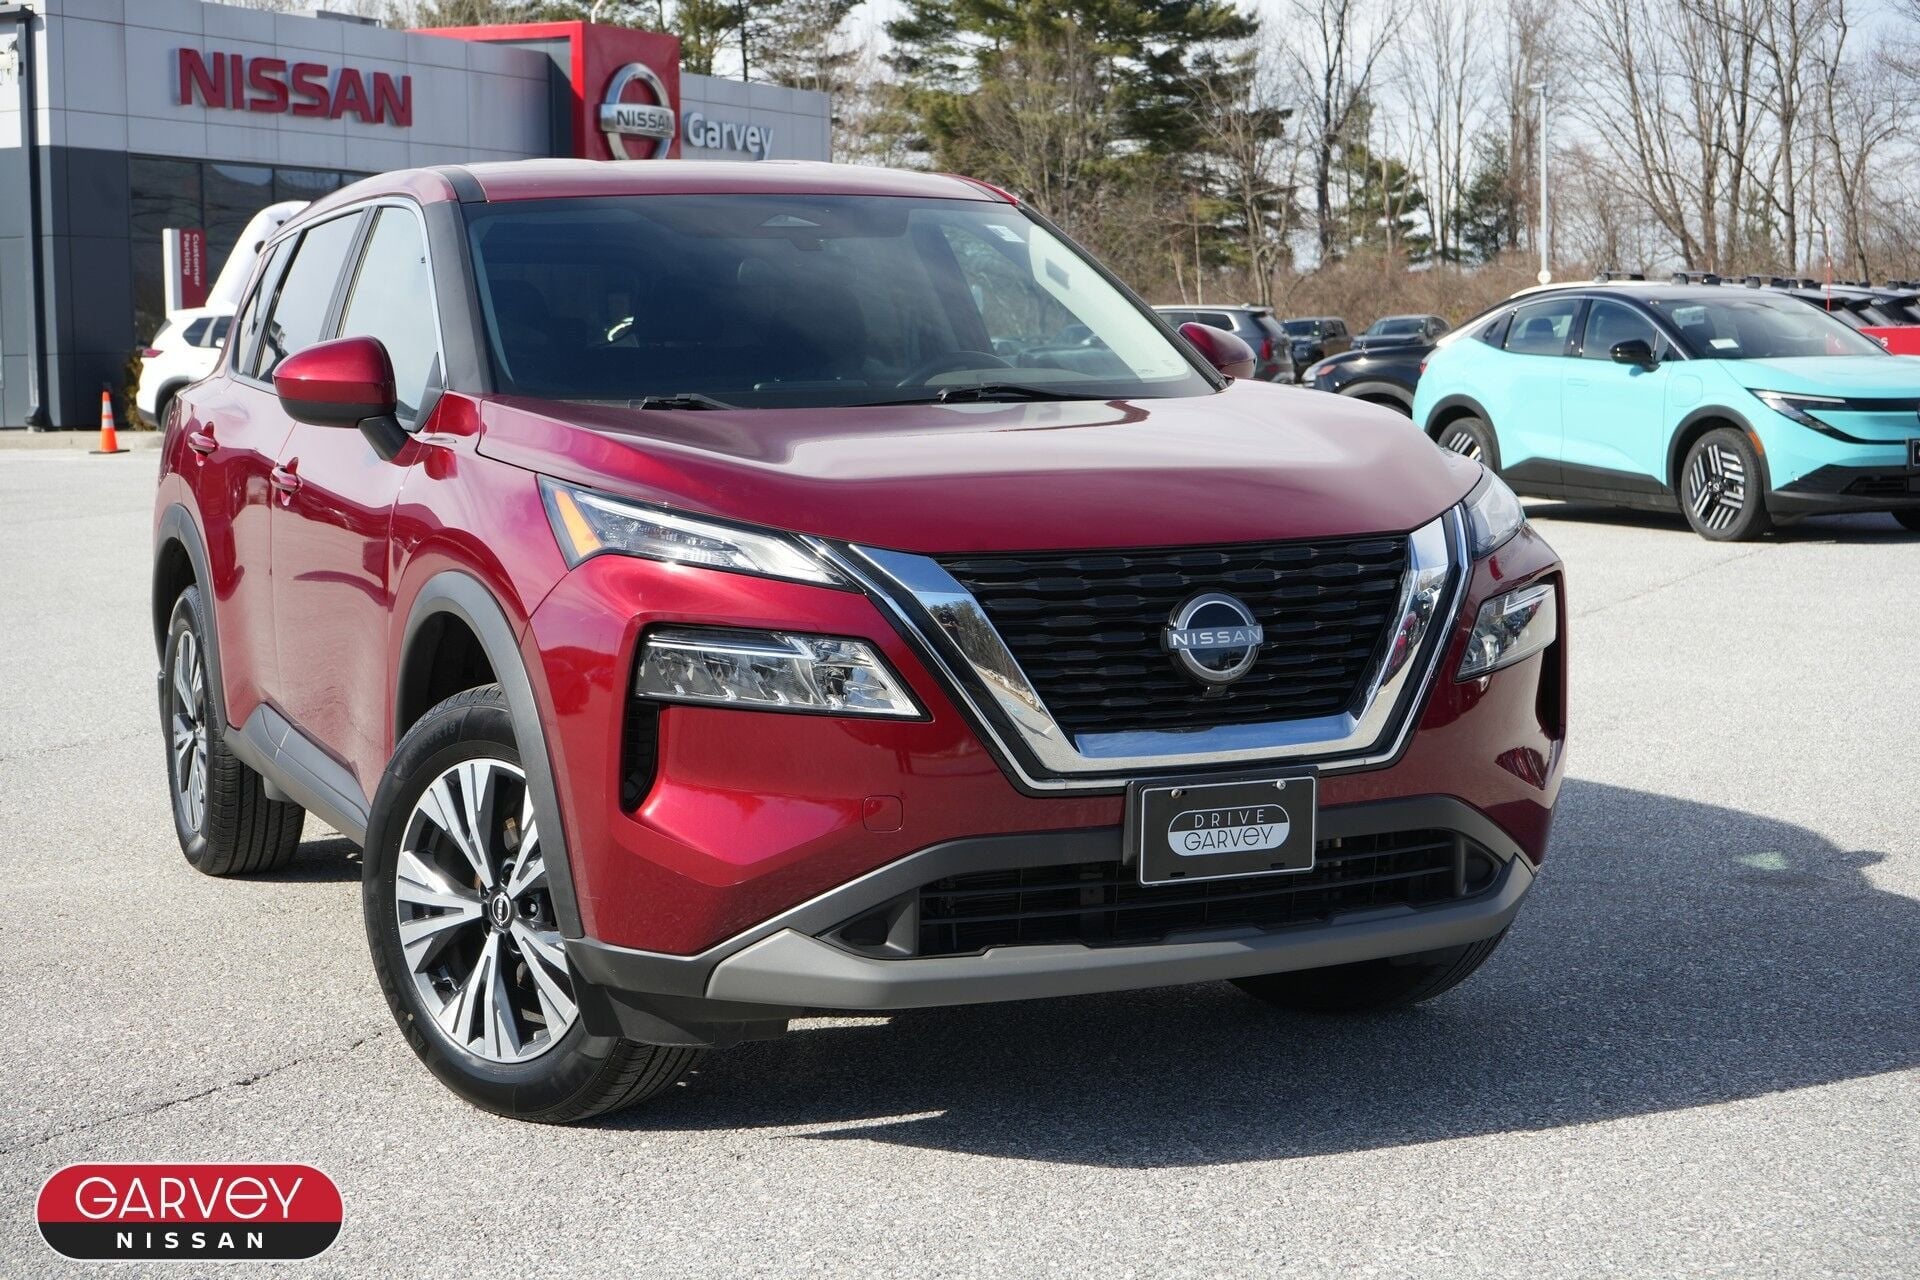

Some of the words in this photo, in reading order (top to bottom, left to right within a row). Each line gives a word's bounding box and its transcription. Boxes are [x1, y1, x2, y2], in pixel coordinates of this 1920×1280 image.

[178, 47, 413, 127] NISSAN
[686, 111, 774, 160] Garvey
[183, 233, 191, 276] Parking
[192, 233, 200, 288] Customer
[1172, 629, 1261, 646] NISSAN
[1194, 809, 1265, 829] DRIVE
